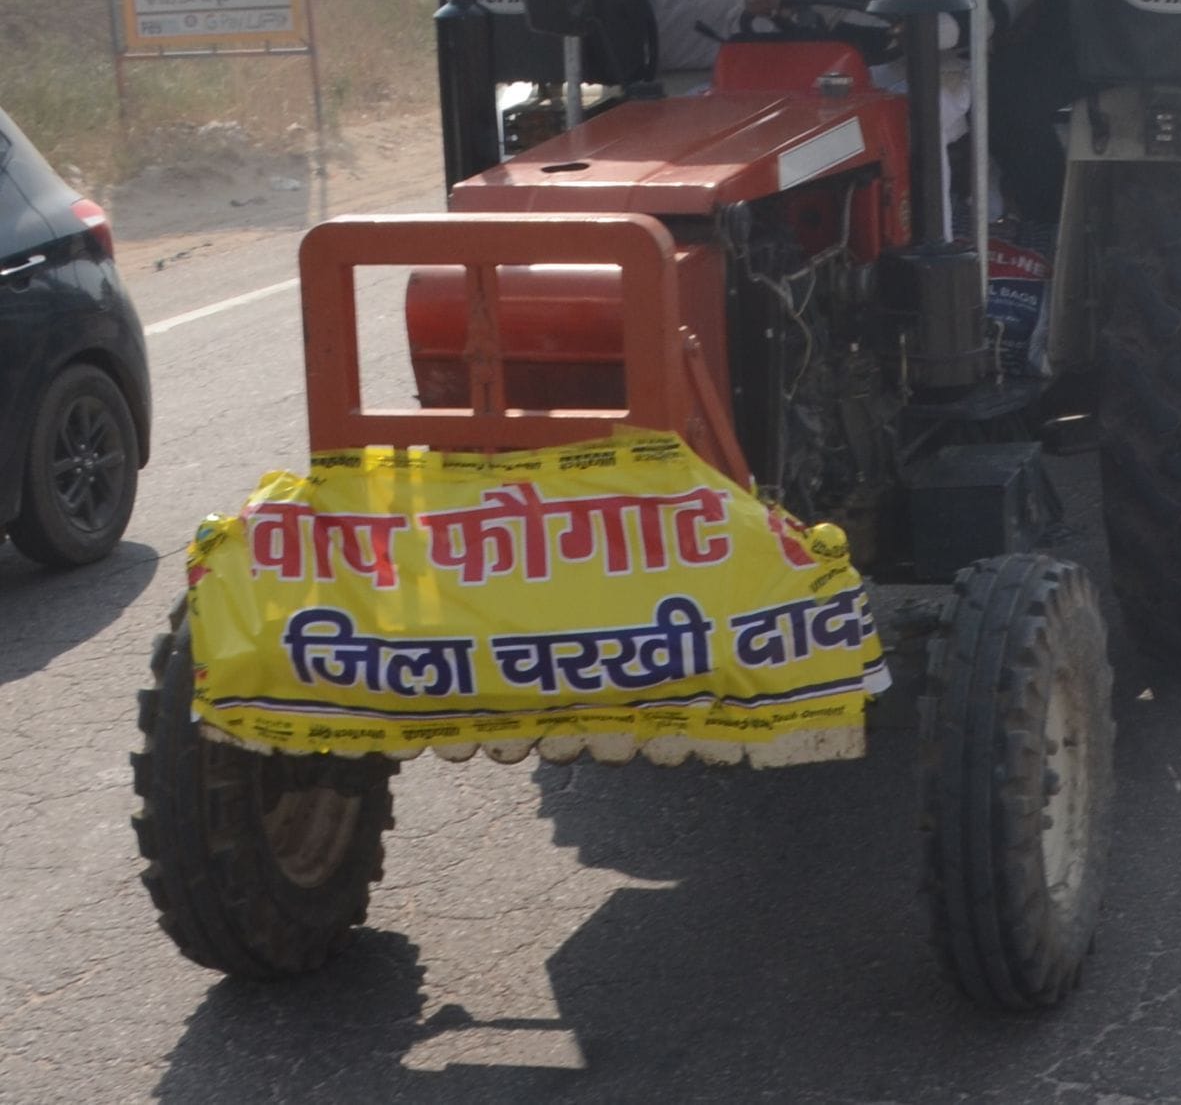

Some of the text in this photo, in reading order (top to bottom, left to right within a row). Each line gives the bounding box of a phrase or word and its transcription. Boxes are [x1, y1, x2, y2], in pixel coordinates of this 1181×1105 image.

[419, 481, 728, 585] फौगाट
[283, 607, 474, 695] जिला
[493, 597, 713, 693] चरखी
